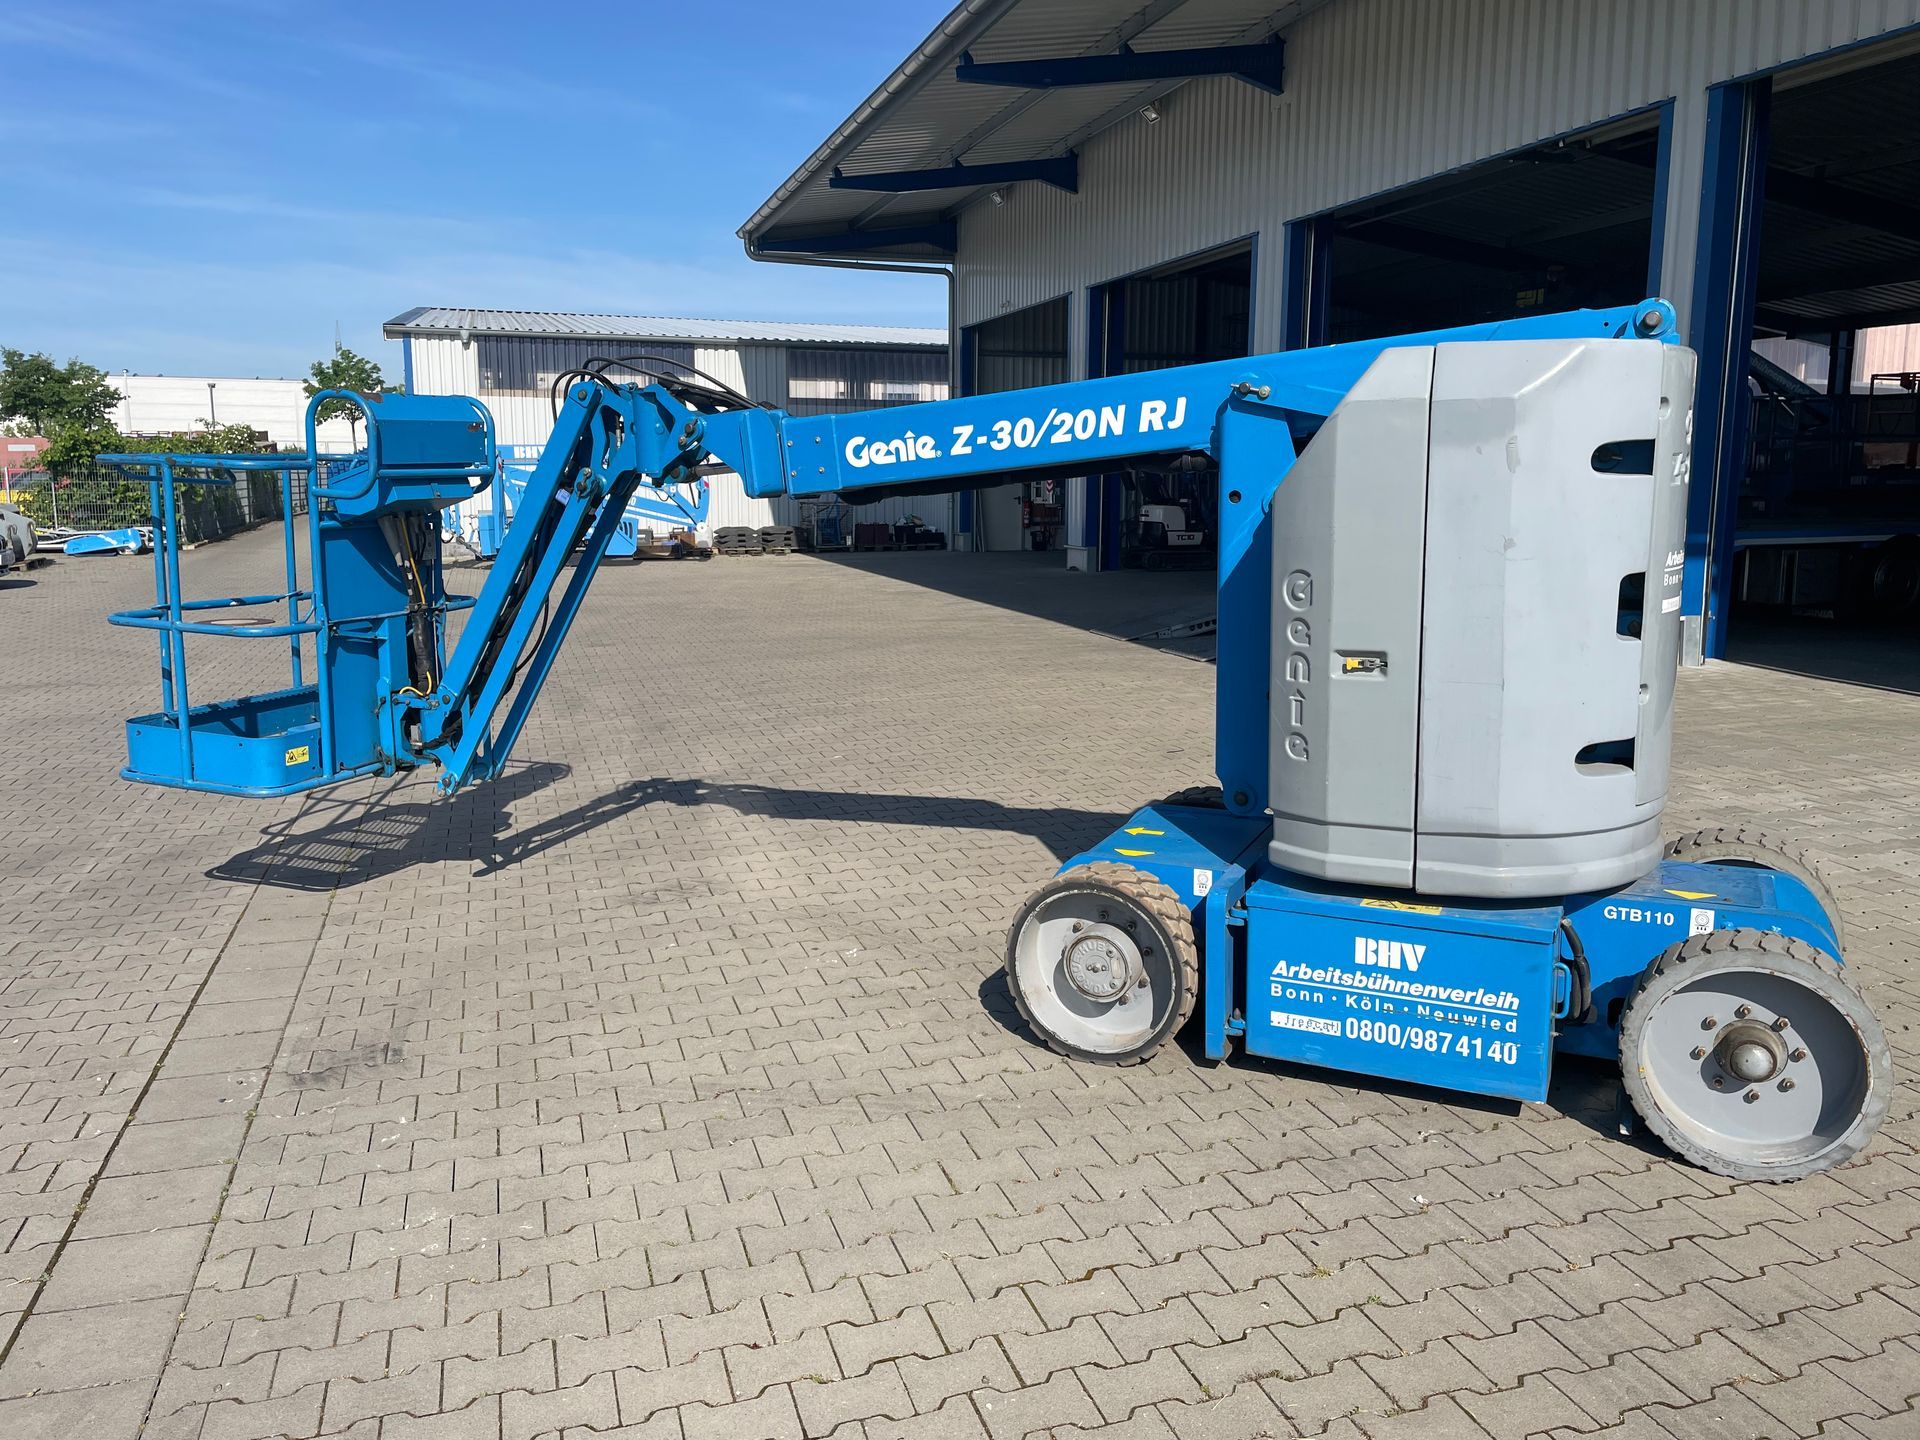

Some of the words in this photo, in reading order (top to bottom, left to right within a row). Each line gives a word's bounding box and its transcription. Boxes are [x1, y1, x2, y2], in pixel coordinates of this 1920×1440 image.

[950, 404, 1126, 456] Z-30/20N
[1138, 396, 1187, 433] RJ
[1283, 568, 1314, 764] Genie
[1603, 905, 1675, 926] GTB110
[1354, 936, 1427, 972] BHV
[1270, 983, 1324, 1003] Bonn
[1345, 993, 1394, 1014] Köln
[1417, 1004, 1517, 1033] Neuwied
[1271, 959, 1520, 1011] Arbeitsbühnenverleih
